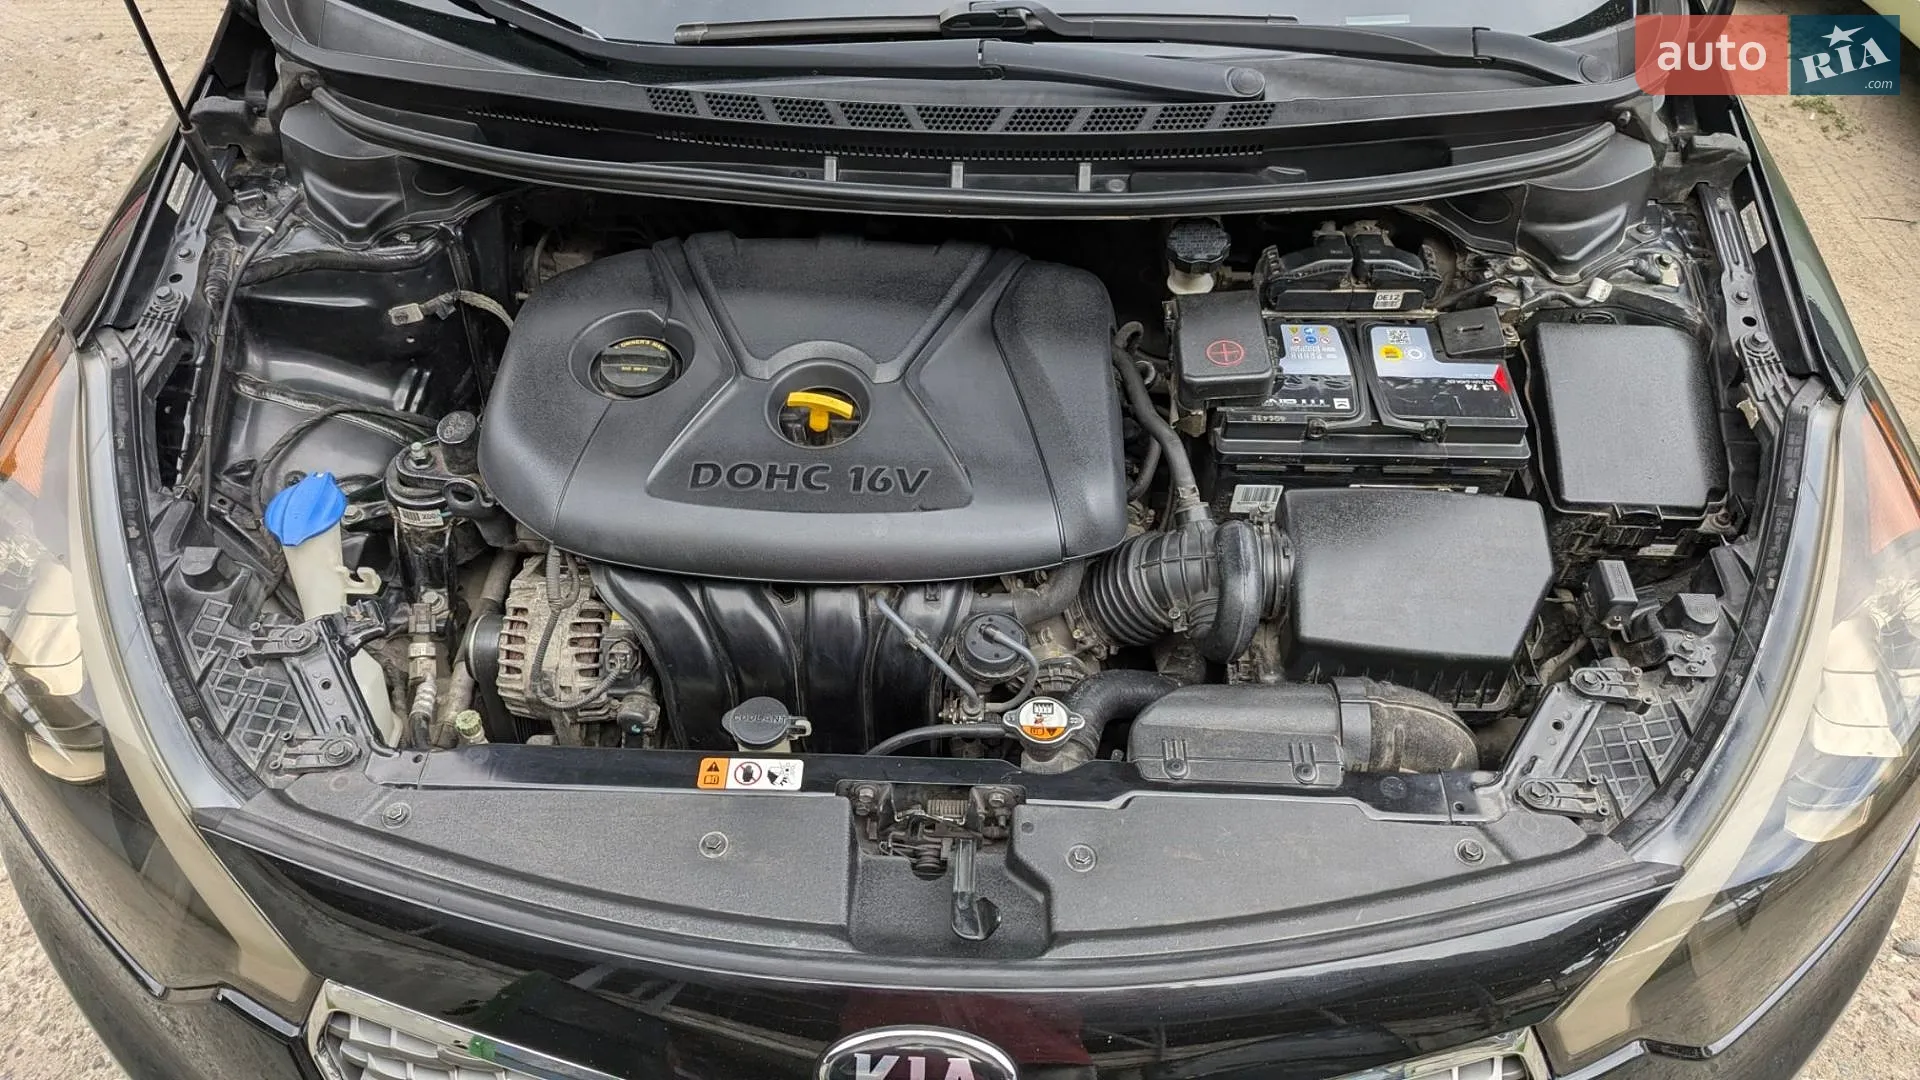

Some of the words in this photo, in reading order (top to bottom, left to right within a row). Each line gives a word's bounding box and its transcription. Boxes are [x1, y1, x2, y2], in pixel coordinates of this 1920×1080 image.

[1482, 384, 1498, 392] L3
[690, 462, 831, 492] DOHC
[849, 466, 931, 497] 16V
[733, 711, 786, 724] COOLANT
